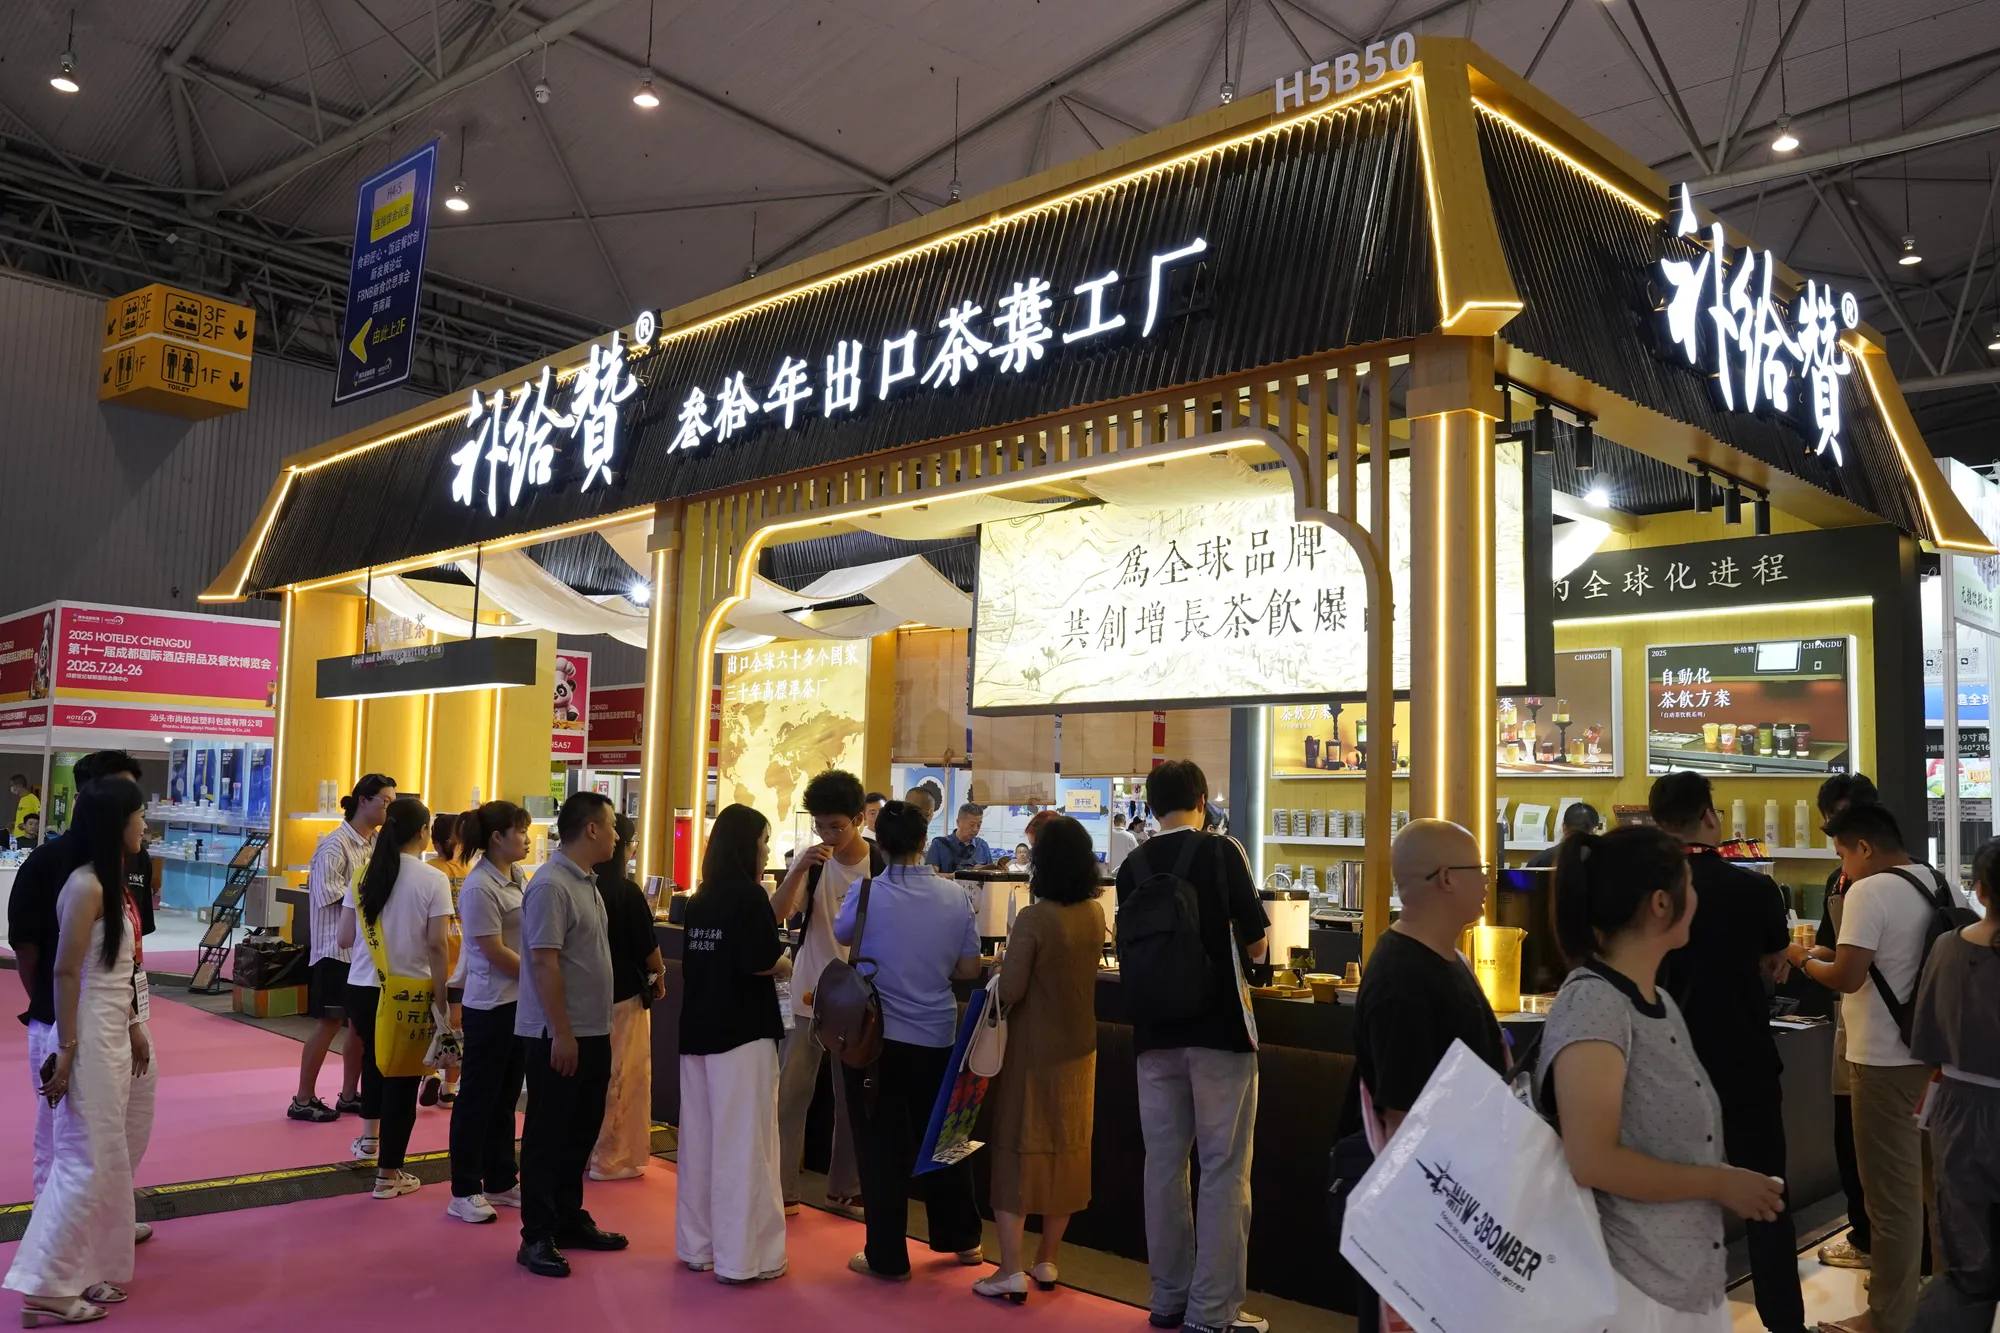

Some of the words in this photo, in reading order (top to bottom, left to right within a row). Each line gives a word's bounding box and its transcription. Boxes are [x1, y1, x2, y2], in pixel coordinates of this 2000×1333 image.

[1275, 31, 1416, 114] H5B50
[140, 293, 152, 311] 3F
[138, 310, 151, 329] 2F
[204, 305, 227, 323] 3F
[202, 322, 225, 340] 2F
[372, 317, 407, 345] 由此上2F
[135, 355, 147, 373] 1F
[200, 367, 222, 384] 1F
[167, 383, 191, 393] TOILET
[1061, 586, 1396, 652] 共創增長茶飲爆
[68, 629, 94, 641] 2025
[95, 632, 138, 645] HOTELEX
[140, 636, 192, 649] CHENGDU
[1803, 640, 1843, 650] CHENGDU
[68, 642, 272, 670] 第十一届成都国际酒店用品及餐饮博览会
[1574, 652, 1608, 661] CHENGDU
[1651, 649, 1667, 657] 2025
[66, 659, 143, 676] 2025.7.24-26
[1661, 667, 1712, 687] 自動化
[1657, 688, 1731, 709] 茶飲方案
[66, 712, 93, 723] HOTELEX
[149, 713, 263, 728] 汕头市尚柏益塑料包装有限公司
[1482, 1257, 1501, 1277] coffee
[1502, 1275, 1526, 1293] wares
